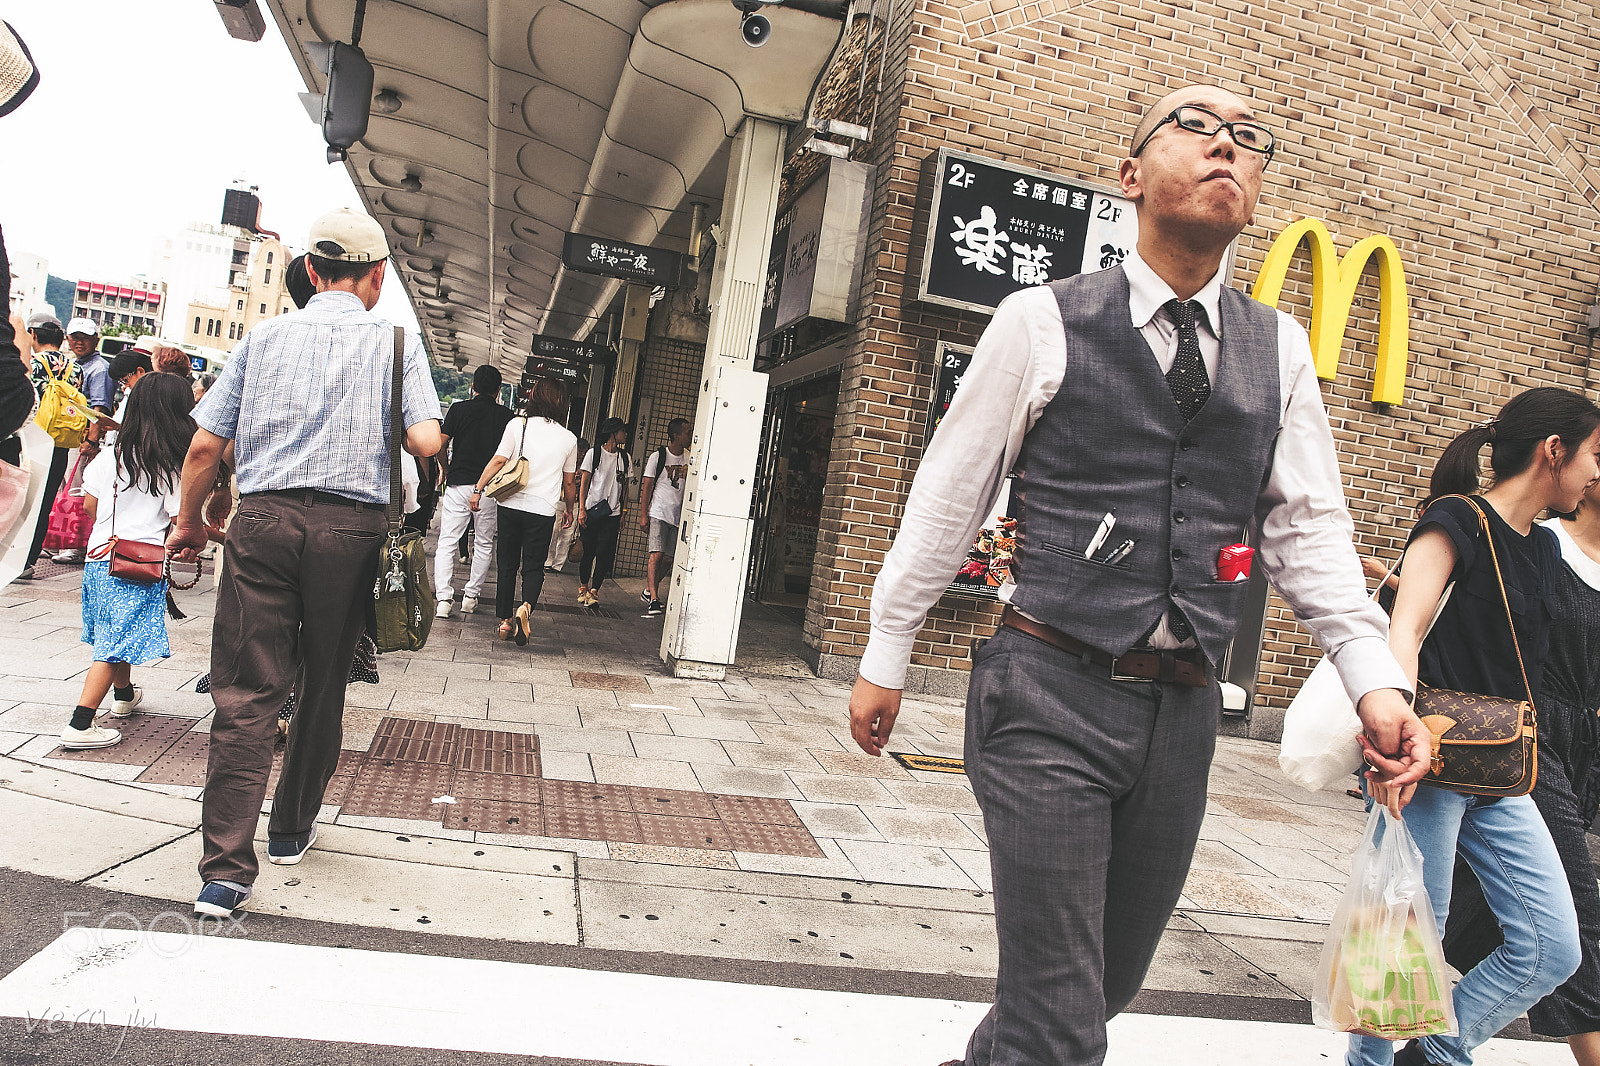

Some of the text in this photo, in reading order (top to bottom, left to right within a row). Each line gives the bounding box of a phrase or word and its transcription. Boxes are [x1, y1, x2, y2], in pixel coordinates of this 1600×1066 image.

[948, 163, 976, 189] 2F
[1012, 178, 1088, 211] 全席個室
[1096, 199, 1122, 223] 2F
[945, 354, 961, 369] 2F
